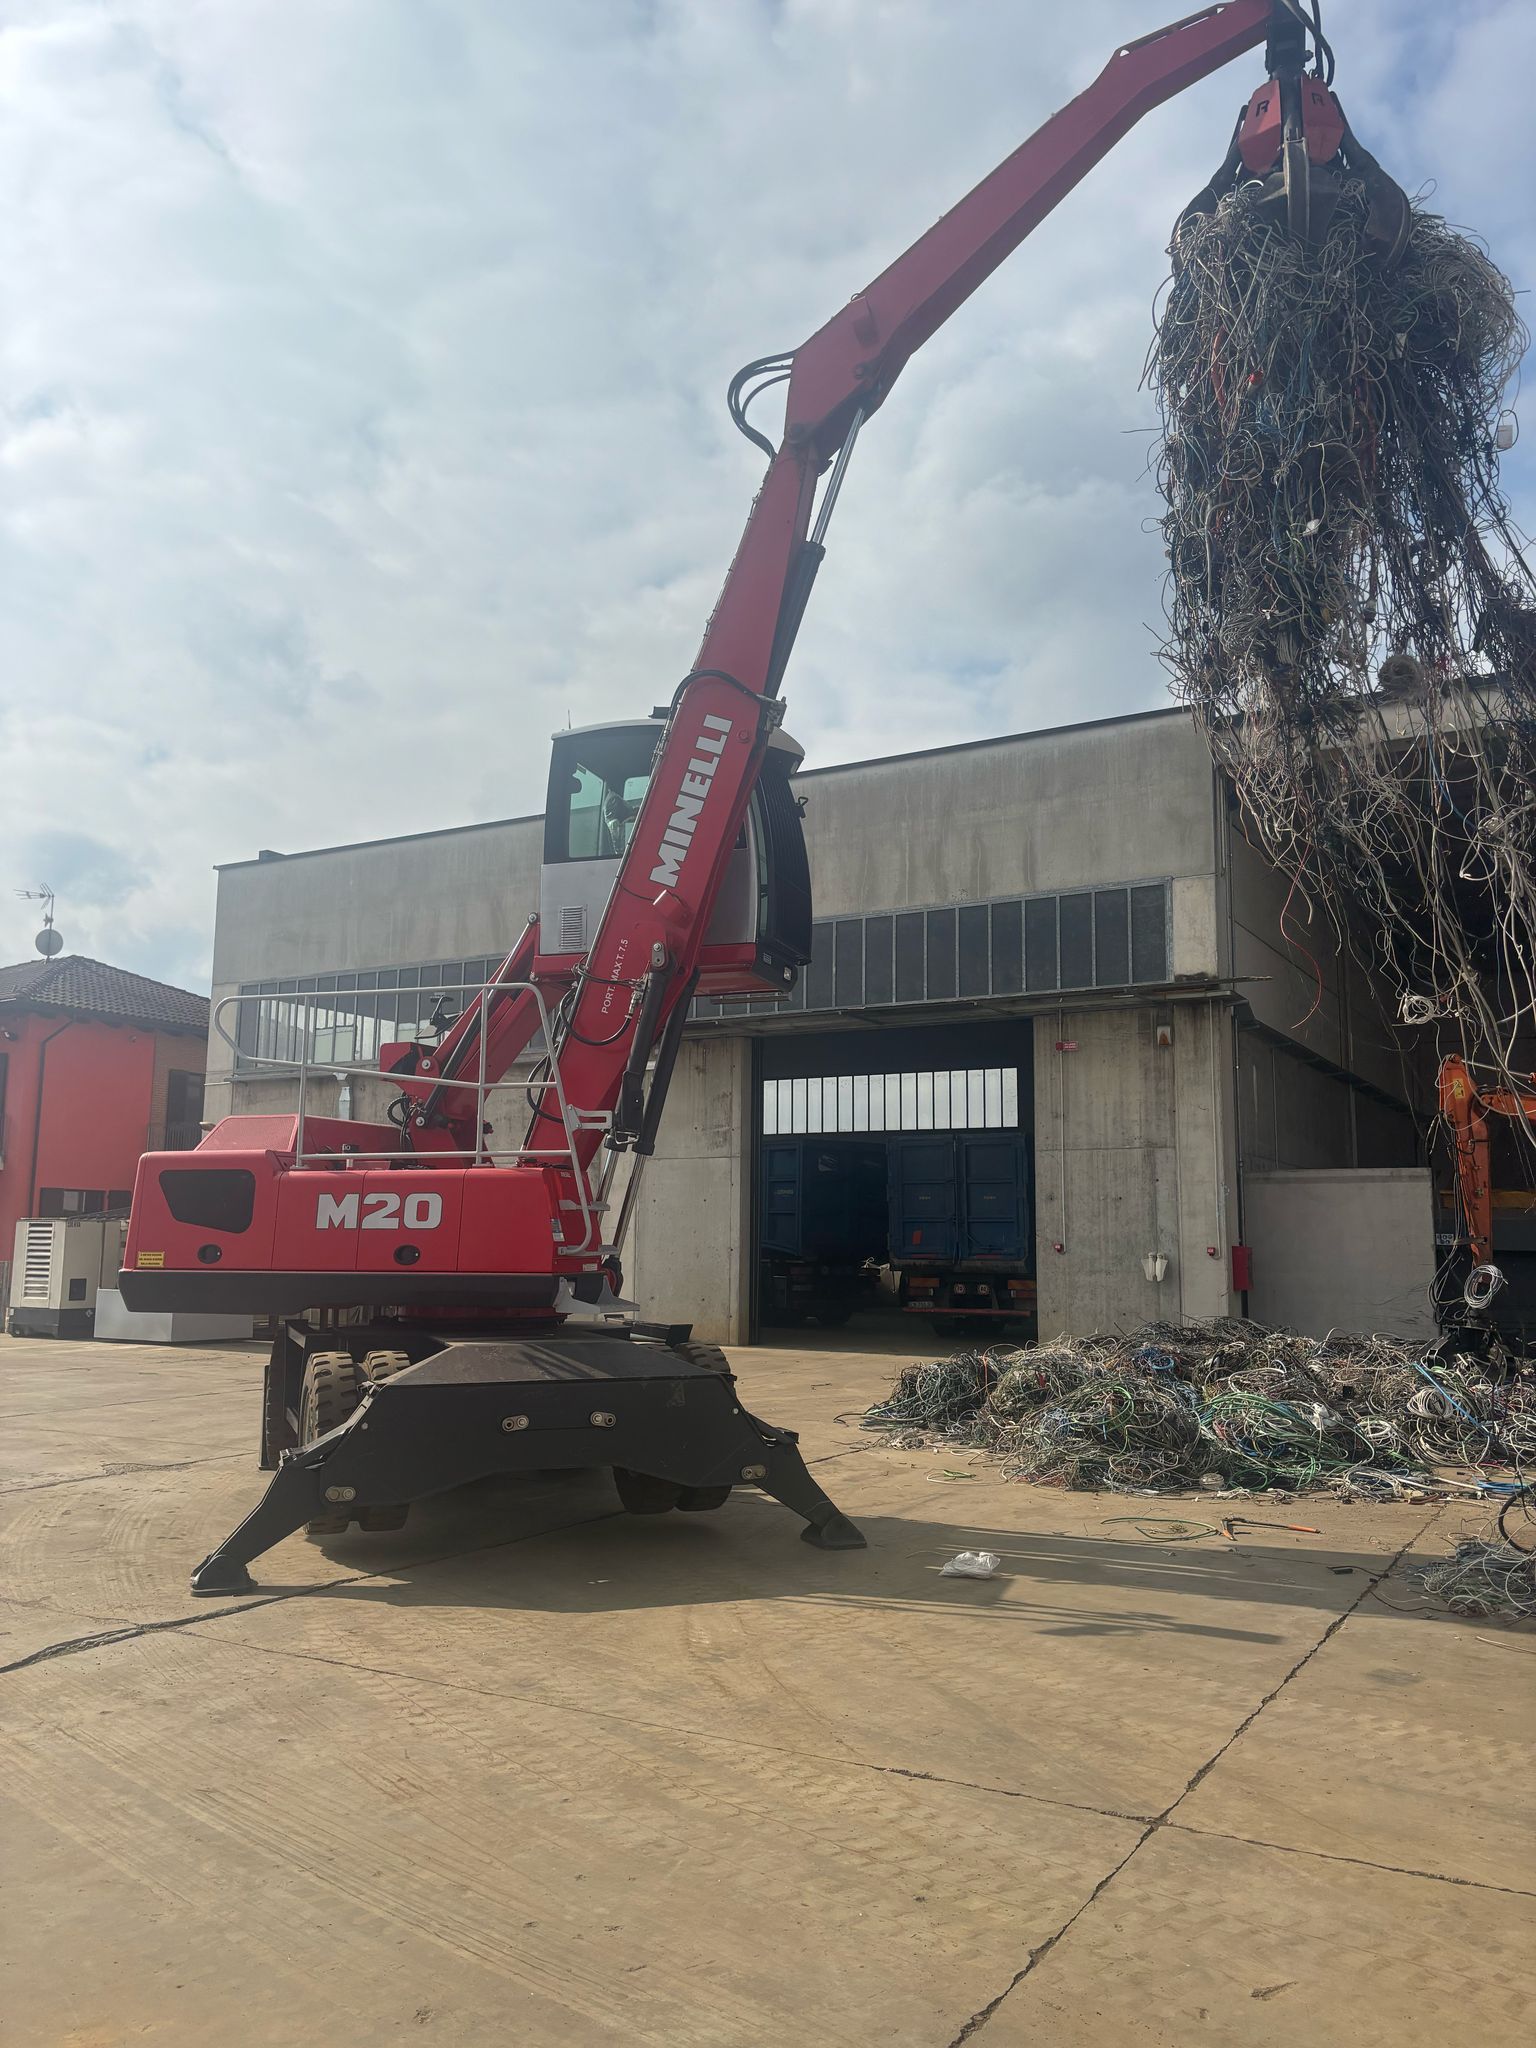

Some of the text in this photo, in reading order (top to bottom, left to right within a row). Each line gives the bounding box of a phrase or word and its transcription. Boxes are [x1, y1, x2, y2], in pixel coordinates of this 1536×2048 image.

[649, 714, 733, 888] MINELLI
[601, 986, 616, 1014] PORT.
[619, 939, 628, 951] 7.5
[316, 1192, 443, 1229] M20
